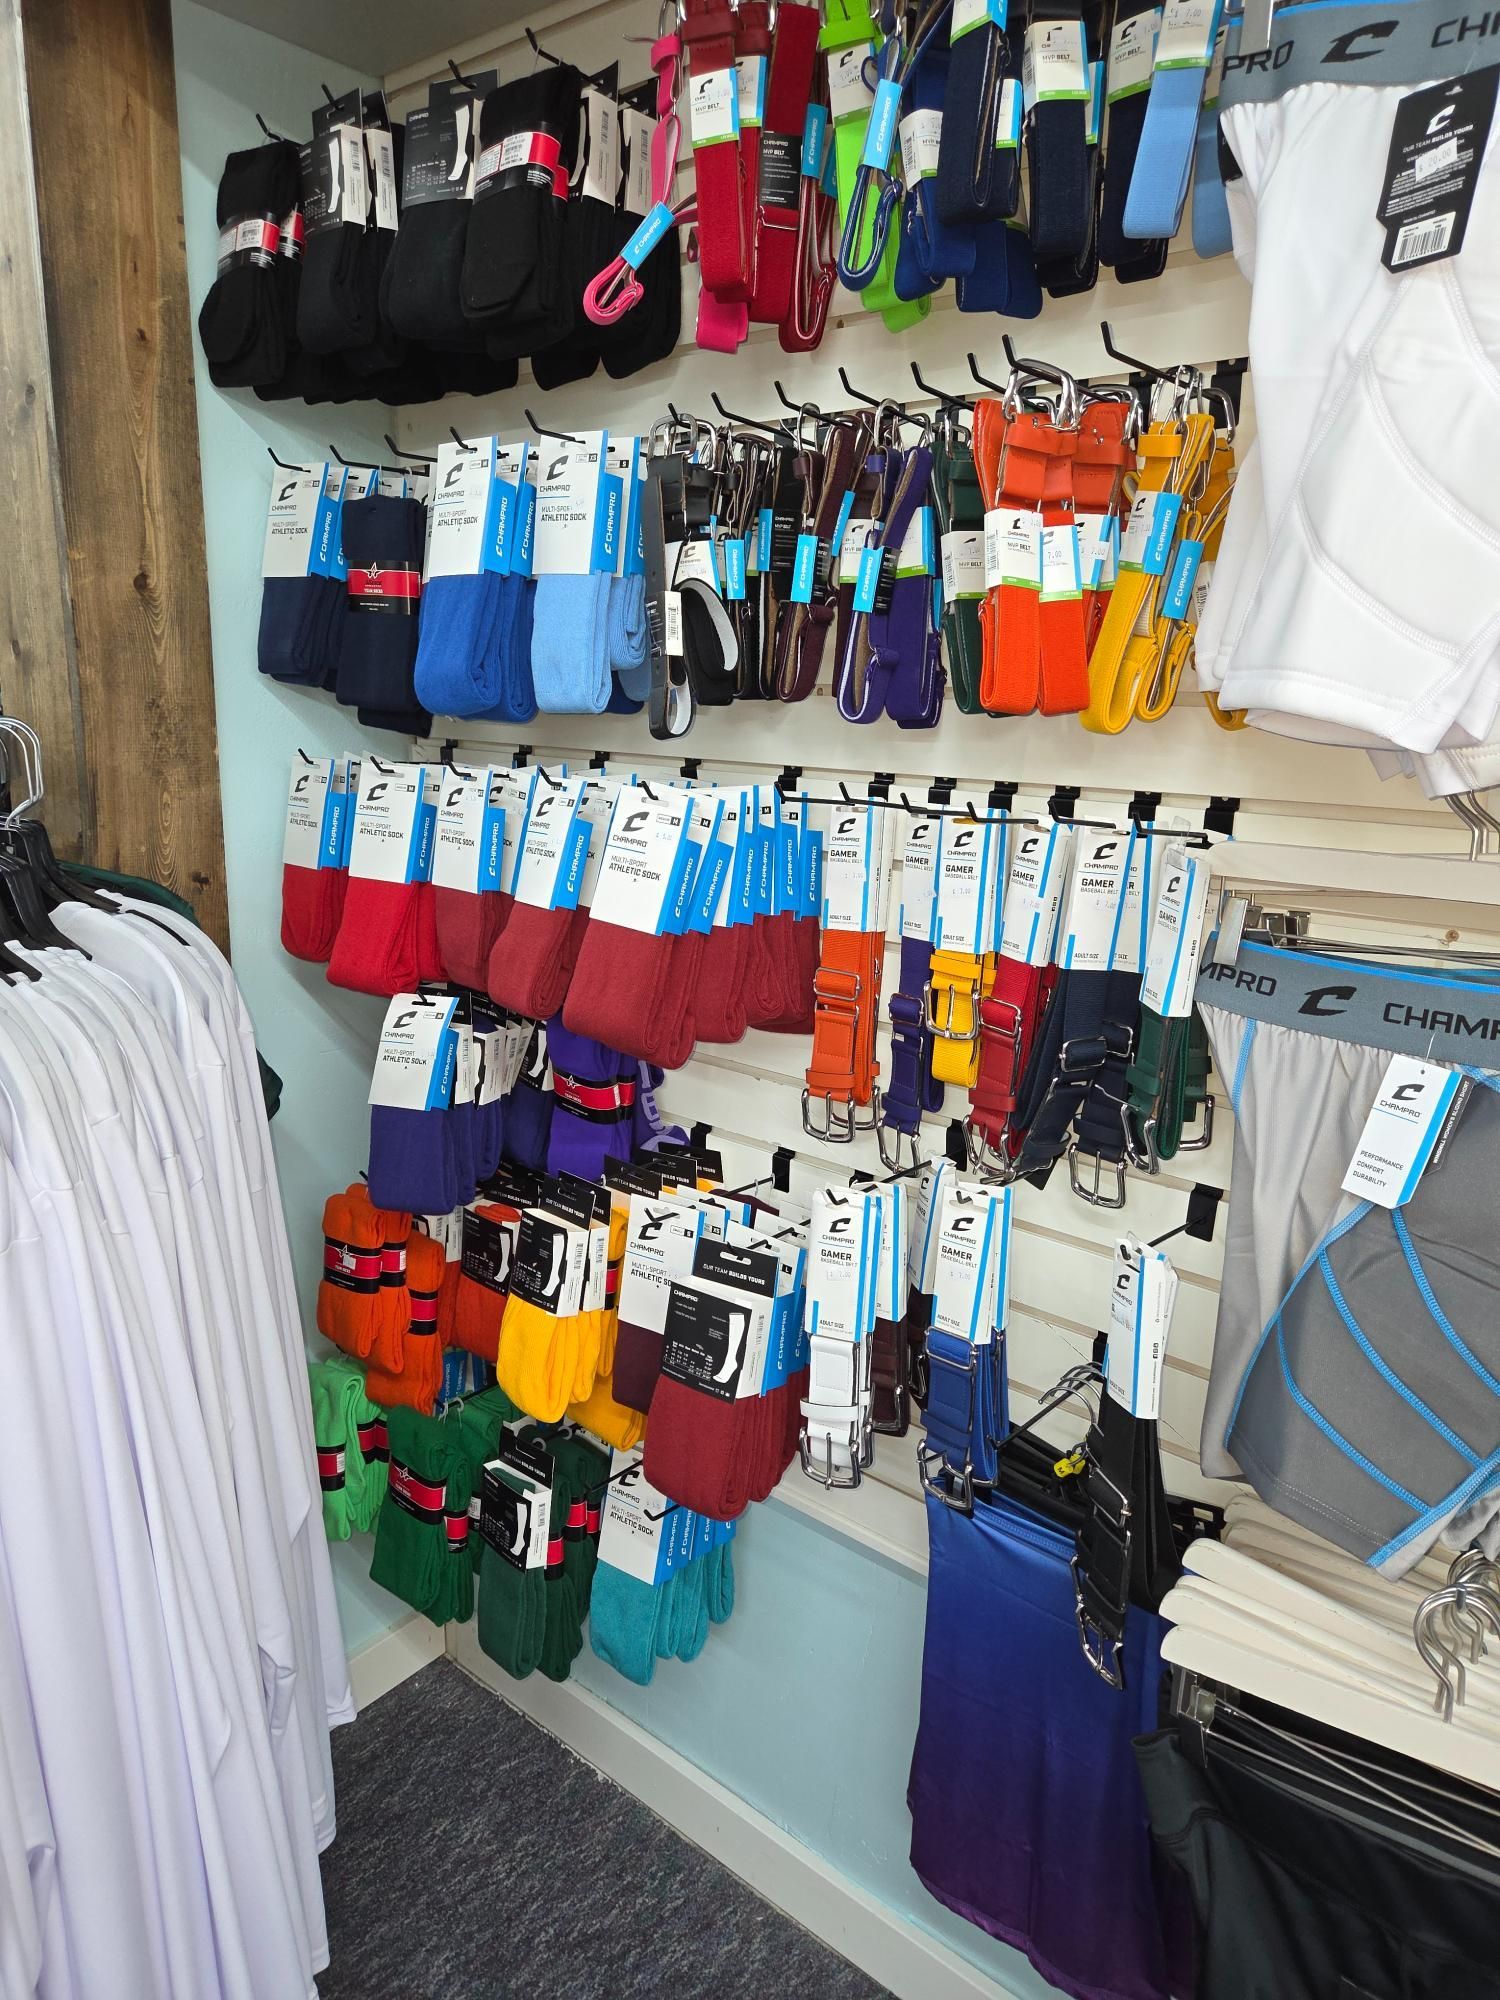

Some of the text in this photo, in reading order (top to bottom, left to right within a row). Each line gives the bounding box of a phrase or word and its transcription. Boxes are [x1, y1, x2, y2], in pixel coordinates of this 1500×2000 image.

[1127, 46, 1140, 56] BELT
[878, 97, 891, 139] CHAMPRO
[810, 118, 818, 155] CHAMPRO
[1416, 139, 1431, 149] TEAM
[1428, 147, 1452, 167] 20.00
[639, 218, 661, 247] CHAMPRO
[438, 490, 464, 499] CHAMPRO
[540, 484, 570, 492] CHAMPRO
[439, 509, 467, 518] MULTI-SPORT
[498, 496, 508, 544] CHAMPRO
[541, 514, 568, 522] ATHLETIC
[606, 492, 616, 542] CHAMPRO
[438, 516, 478, 527] ATHLETIC SOCK
[523, 501, 535, 547] CHAMPRO
[321, 511, 332, 552] CHAMPRO
[1008, 531, 1030, 539] CHAMPRO
[1158, 510, 1172, 552] CHAMPRO
[801, 545, 809, 579] CHAMPRO
[864, 556, 872, 591] CHAMPRO
[1177, 557, 1192, 598] CHAMPRO
[440, 810, 463, 818] CHAMPRO
[290, 818, 318, 828] ATHLETIC SOCK
[330, 807, 340, 845] CHAMPRO
[530, 821, 550, 829] CHAMPRO
[673, 818, 679, 826] M
[360, 828, 404, 838] ATHLETIC SOCK
[420, 817, 430, 858] CHAMPRO
[441, 828, 465, 836] MULTI-SPORT
[441, 835, 475, 846] ATHLETIC SOCK
[490, 823, 499, 865] CHAMPRO
[612, 835, 648, 847] CHAMPRO
[526, 846, 556, 858] ATHLETIC SOCK
[569, 835, 584, 881] CHAMPRO
[830, 849, 857, 858] GAMER
[611, 856, 648, 869] MULTI-SPORT
[761, 841, 769, 886] CHAMPRO
[905, 855, 929, 865] GAMER
[1015, 855, 1038, 865] CHAMPRO
[1084, 863, 1118, 871] CHAMPRO
[608, 863, 661, 881] ATHLETIC SOCK
[745, 849, 754, 896] CHAMPRO
[945, 865, 973, 874] GAMER
[1012, 869, 1034, 882] GAMER
[677, 858, 693, 905] CHAMPRO
[706, 859, 723, 905] CHAMPRO
[1081, 878, 1114, 888] GAMER
[1158, 910, 1177, 925] GAMER
[384, 1031, 415, 1040] CHAMPRO
[384, 1048, 415, 1056] MULTI-SPORT
[383, 1055, 427, 1065] ATHLETIC SOCK
[442, 1043, 454, 1085] CHAMPRO
[1459, 1081, 1470, 1097] SHORT
[1380, 1100, 1421, 1118] CHAMPRO
[1356, 1161, 1384, 1175] COMFORT
[1360, 1150, 1404, 1171] PERFORMANCE
[1353, 1171, 1387, 1187] DURABILITY
[561, 1204, 585, 1219] BUILDS YOURS
[822, 1234, 855, 1244] CHAMPRO
[943, 1231, 976, 1245] CHAMPRO
[630, 1241, 665, 1257] CHAMPRO
[821, 1249, 852, 1261] GAMER
[941, 1245, 972, 1261] GAMER
[631, 1261, 667, 1276] MULTI-SPORT
[820, 1258, 845, 1267] BASEBALL
[630, 1268, 662, 1283] ATHLETIC
[703, 1263, 766, 1286] OUR TEAM BUILDS YOURS
[673, 1289, 698, 1301] CHAMPRO
[819, 1319, 834, 1327] ADULT
[779, 1311, 788, 1363] CHAMPRO
[611, 1486, 640, 1504] CHAMPRO
[611, 1505, 642, 1521] MULTI-SPORT
[610, 1511, 654, 1536] ATHLETIC SOCK
[668, 1514, 678, 1555] CHAMPRO
